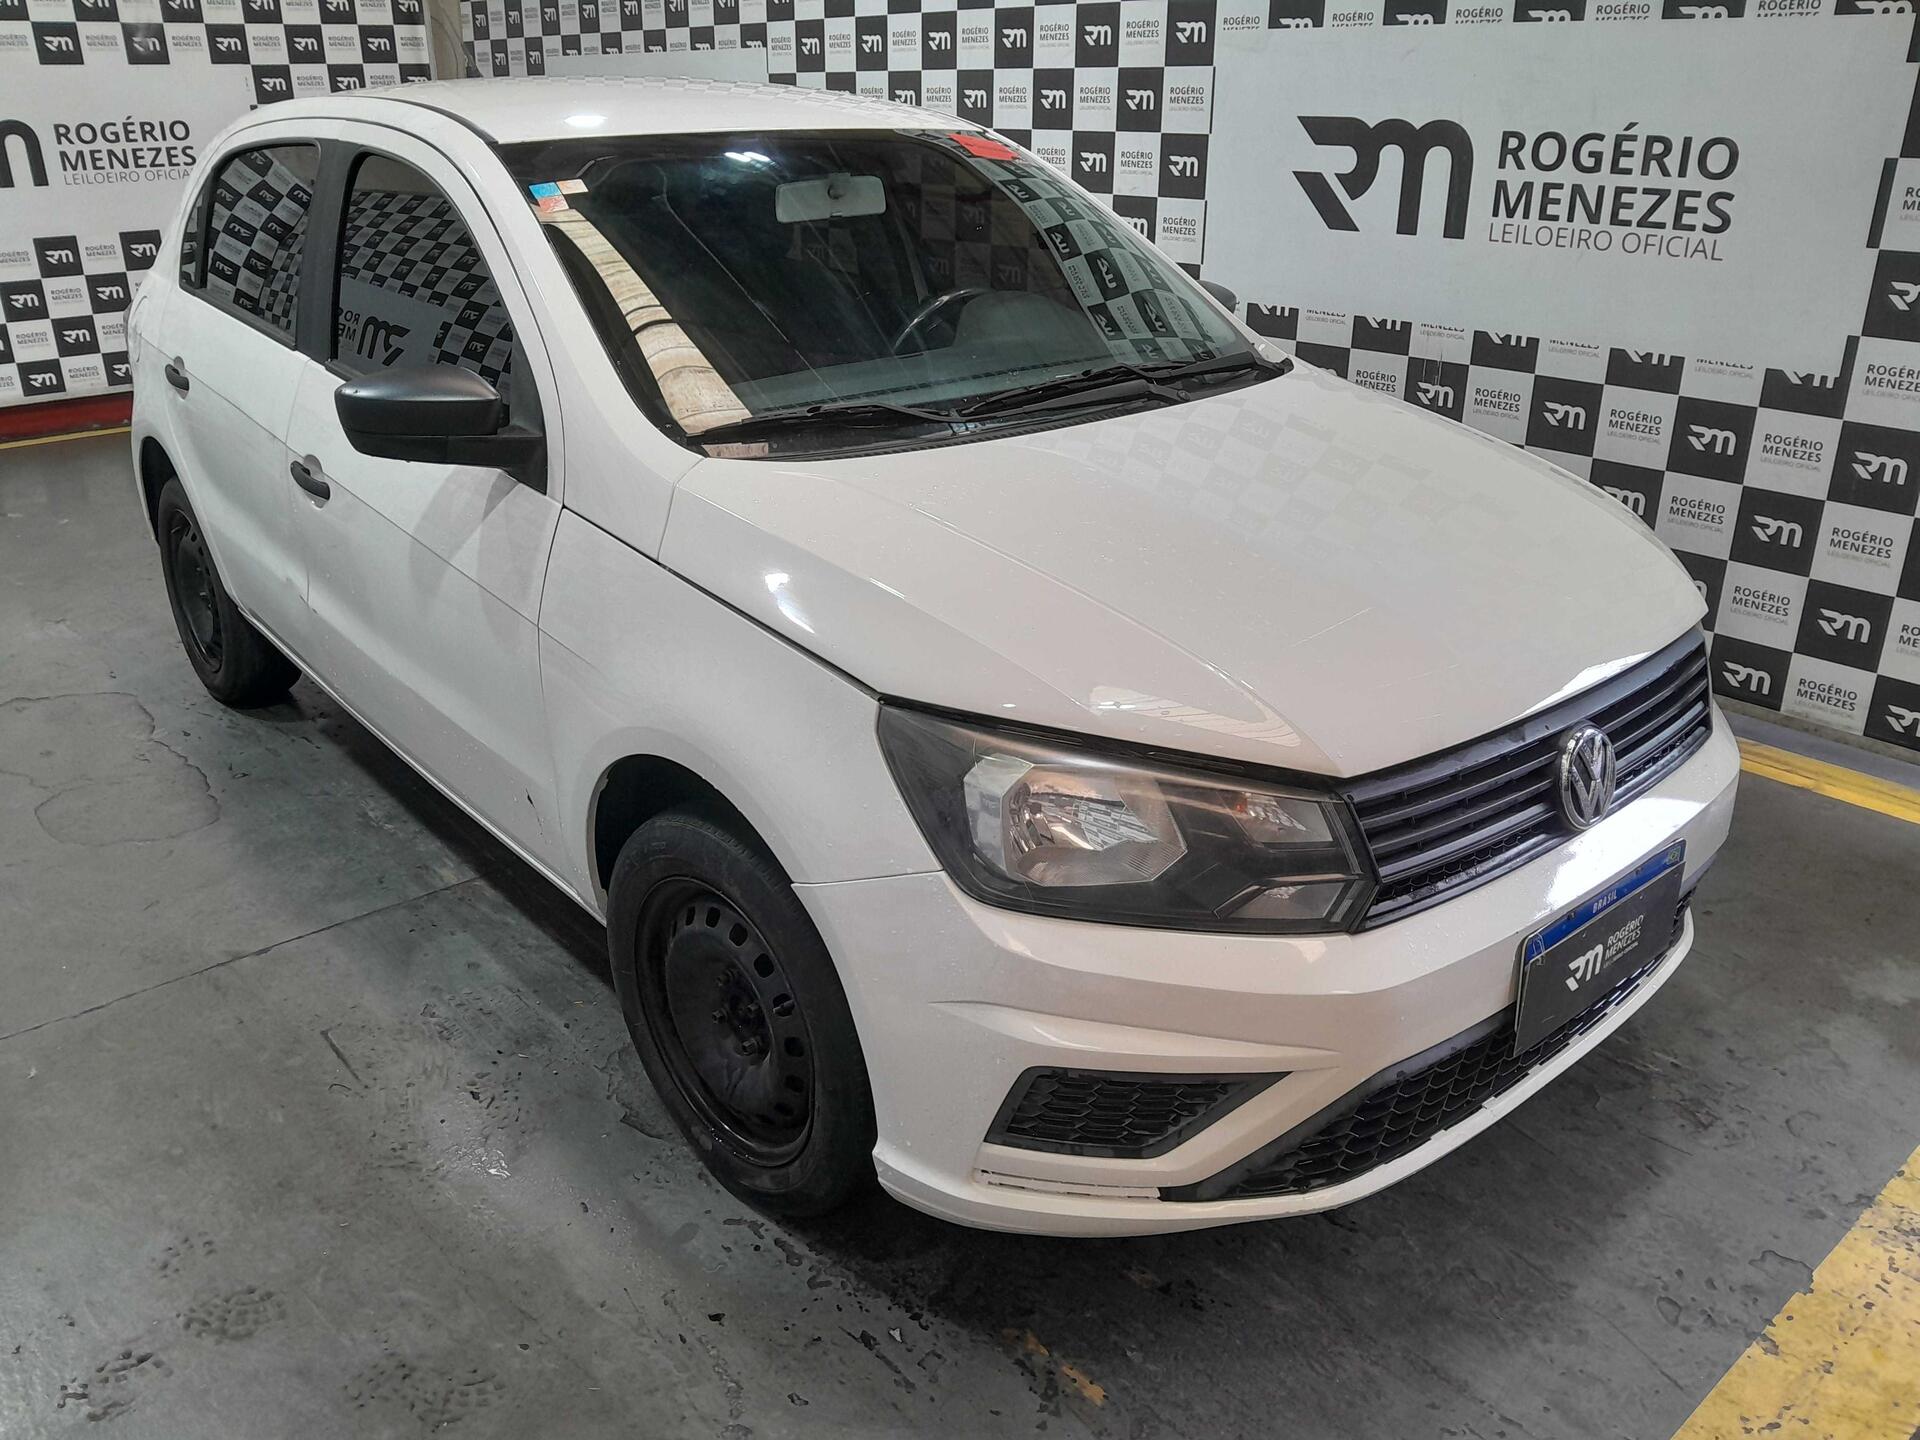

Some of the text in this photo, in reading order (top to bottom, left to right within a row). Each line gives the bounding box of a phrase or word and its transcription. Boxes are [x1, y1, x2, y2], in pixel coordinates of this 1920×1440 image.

[1456, 6, 1503, 18] ROGÉRIO
[1596, 2, 1650, 14] ROGÉRIO
[1224, 14, 1260, 25] ROGÉRIO
[1332, 10, 1374, 22] ROGÉRIO
[962, 26, 988, 35] ROGÉRIO
[1040, 22, 1069, 32] ROGÉRIO
[1126, 18, 1159, 29] ROGÉRIO
[892, 30, 916, 38] ROGÉRIO
[962, 36, 989, 44] MENEZES
[1040, 32, 1069, 41] MENEZES
[1126, 29, 1159, 38] MENEZES
[893, 38, 917, 46] MENEZES
[926, 86, 952, 94] ROGÉRIO
[999, 86, 1027, 95] ROGÉRIO
[1080, 85, 1110, 95] ROGÉRIO
[1170, 84, 1204, 95] ROGÉRIO
[926, 94, 952, 102] MENEZES
[999, 95, 1027, 103] MENEZES
[1080, 95, 1110, 104] MENEZES
[1170, 96, 1204, 105] MENEZES
[53, 116, 190, 145] ROGÉRIO
[59, 146, 196, 171] MENEZES
[1120, 150, 1153, 160] ROGÉRIO
[1498, 122, 1740, 181] ROGÉRIO
[1120, 160, 1153, 169] MENEZES
[64, 168, 193, 185] LEILOEIRO OFICIA
[1491, 180, 1735, 234] MENEZES
[1163, 215, 1196, 226] ROGÉRIO
[1162, 226, 1196, 235] MENEZES
[1488, 222, 1723, 261] LEILOEIRO OFICIAL
[1356, 370, 1396, 383] ROGÉRIO
[1868, 364, 1920, 379] ROGÉRI
[1356, 379, 1396, 393] MENEZES
[1864, 376, 1920, 392] MENEZE
[1476, 388, 1521, 402] ROGÉRIO
[1474, 398, 1520, 412] MENEZES
[1610, 409, 1662, 425] ROGÉRIO
[1608, 420, 1661, 435] MENEZES
[1764, 434, 1824, 451] ROGÉRIO
[1762, 444, 1822, 463] MENEZES
[1671, 496, 1725, 514] ROGÉRIO
[1669, 506, 1724, 525] MENEZES
[1832, 527, 1894, 548] ROGÉRIO
[1830, 538, 1892, 559] MENEZES
[1734, 586, 1790, 606] ROGÉRIO
[1732, 596, 1789, 617] MENEZES
[1800, 678, 1858, 701] ROGÉRIO
[1796, 688, 1856, 712] MENEZES
[1592, 890, 1617, 914] BRASIL
[1608, 914, 1645, 947] ROGÉRIO
[1605, 926, 1642, 960] MENEZES
